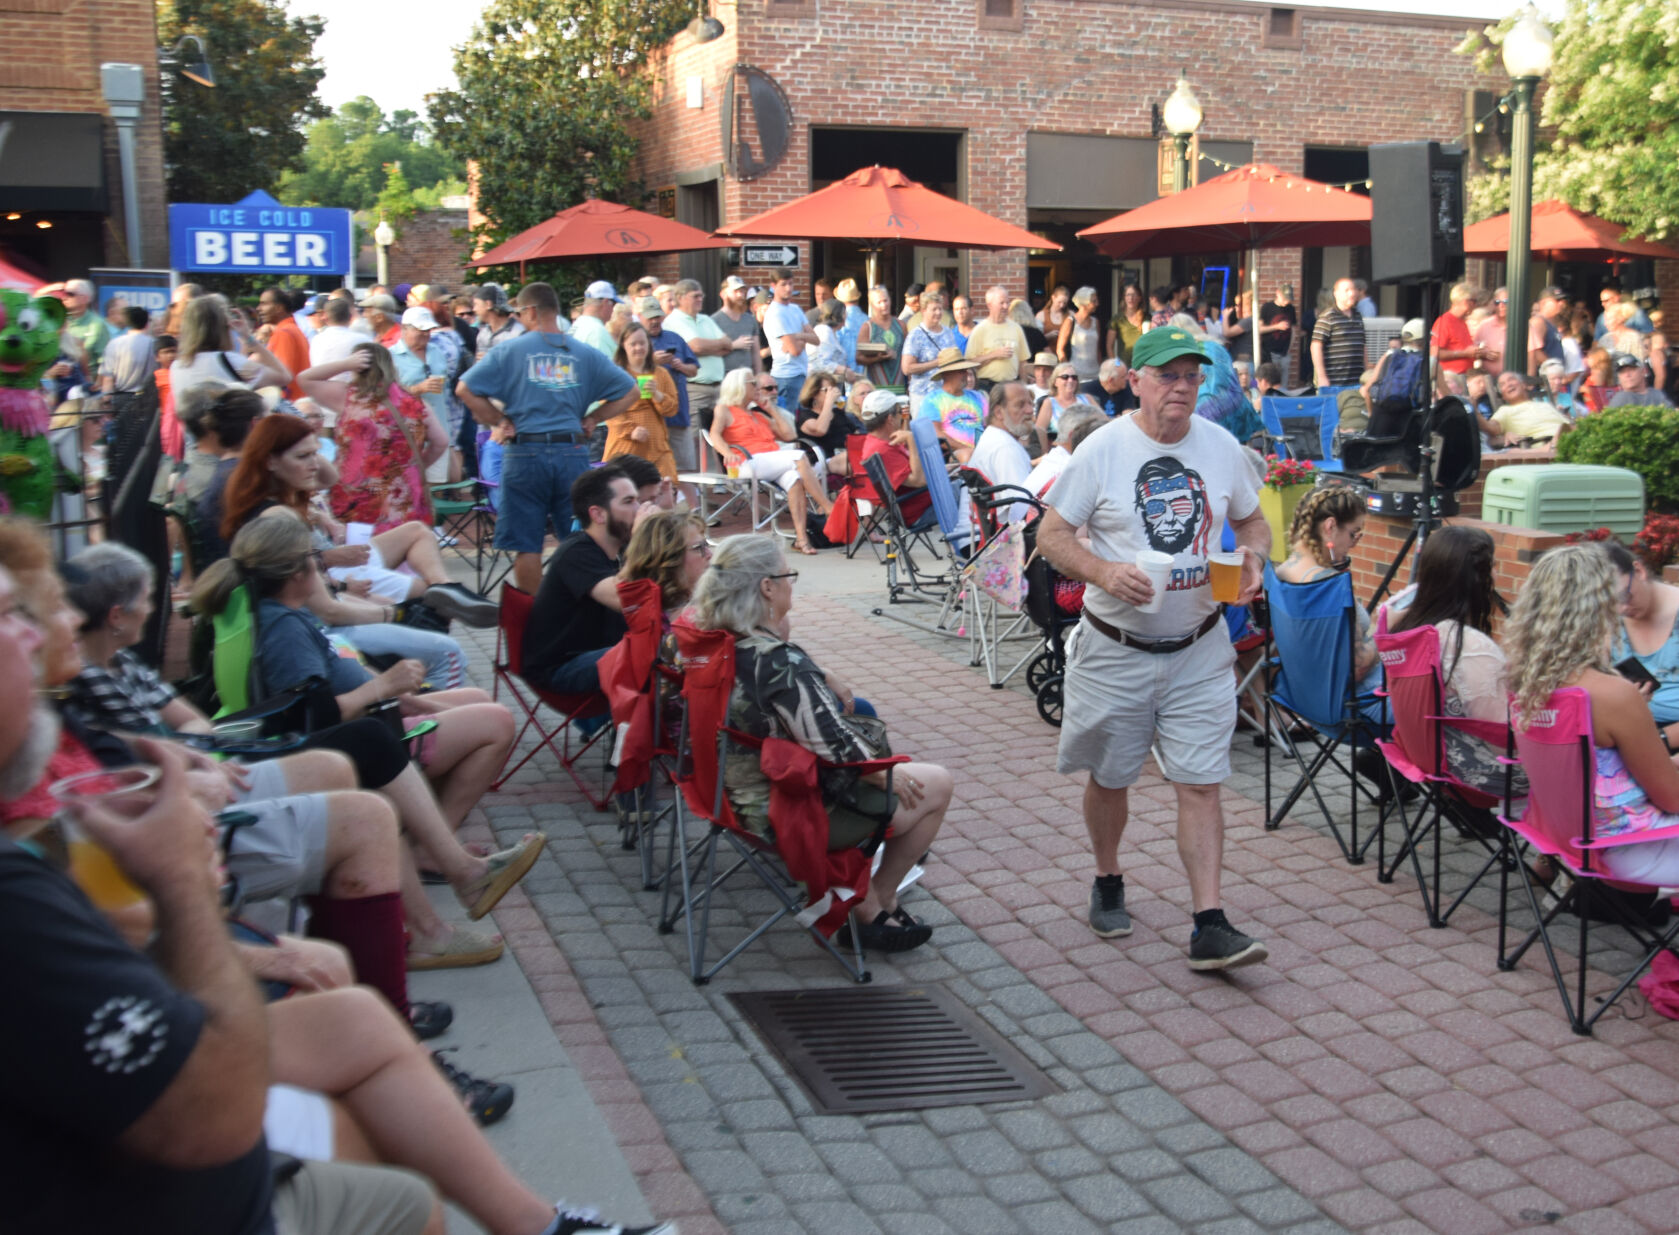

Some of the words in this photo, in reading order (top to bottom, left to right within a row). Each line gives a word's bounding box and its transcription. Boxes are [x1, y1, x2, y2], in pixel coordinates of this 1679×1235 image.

[209, 208, 246, 226] ICE
[259, 210, 313, 227] COLD
[194, 231, 328, 267] BEER
[750, 251, 764, 260] ONE
[768, 251, 783, 260] WAY
